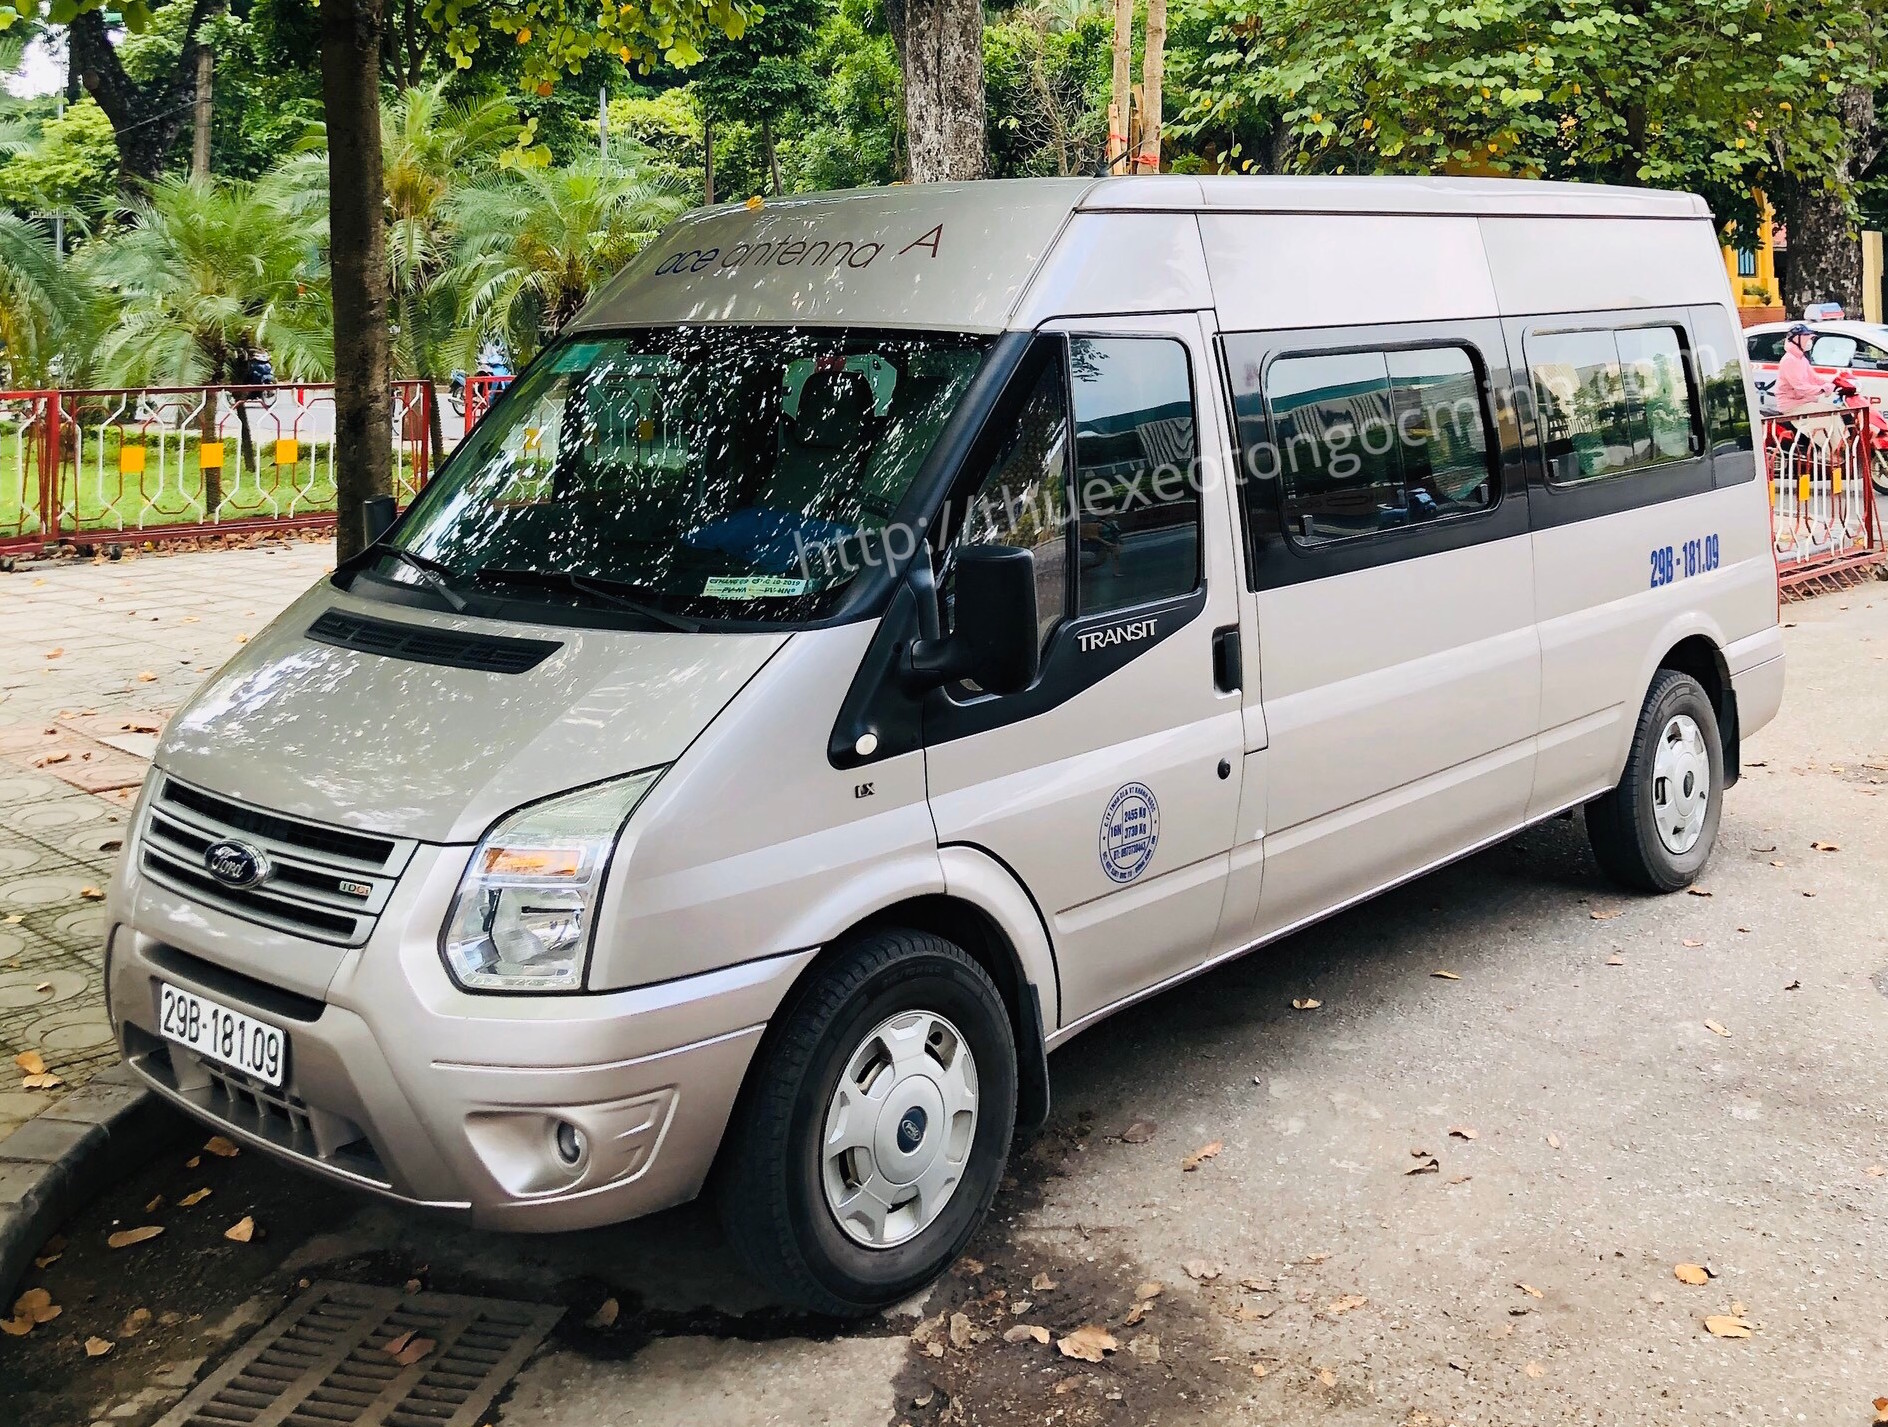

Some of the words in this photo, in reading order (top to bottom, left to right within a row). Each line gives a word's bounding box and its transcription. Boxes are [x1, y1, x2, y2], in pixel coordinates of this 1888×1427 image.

[654, 247, 719, 277] ace
[720, 234, 885, 269] antenna
[1077, 619, 1158, 652] TRANSIT
[211, 847, 247, 878] Ford
